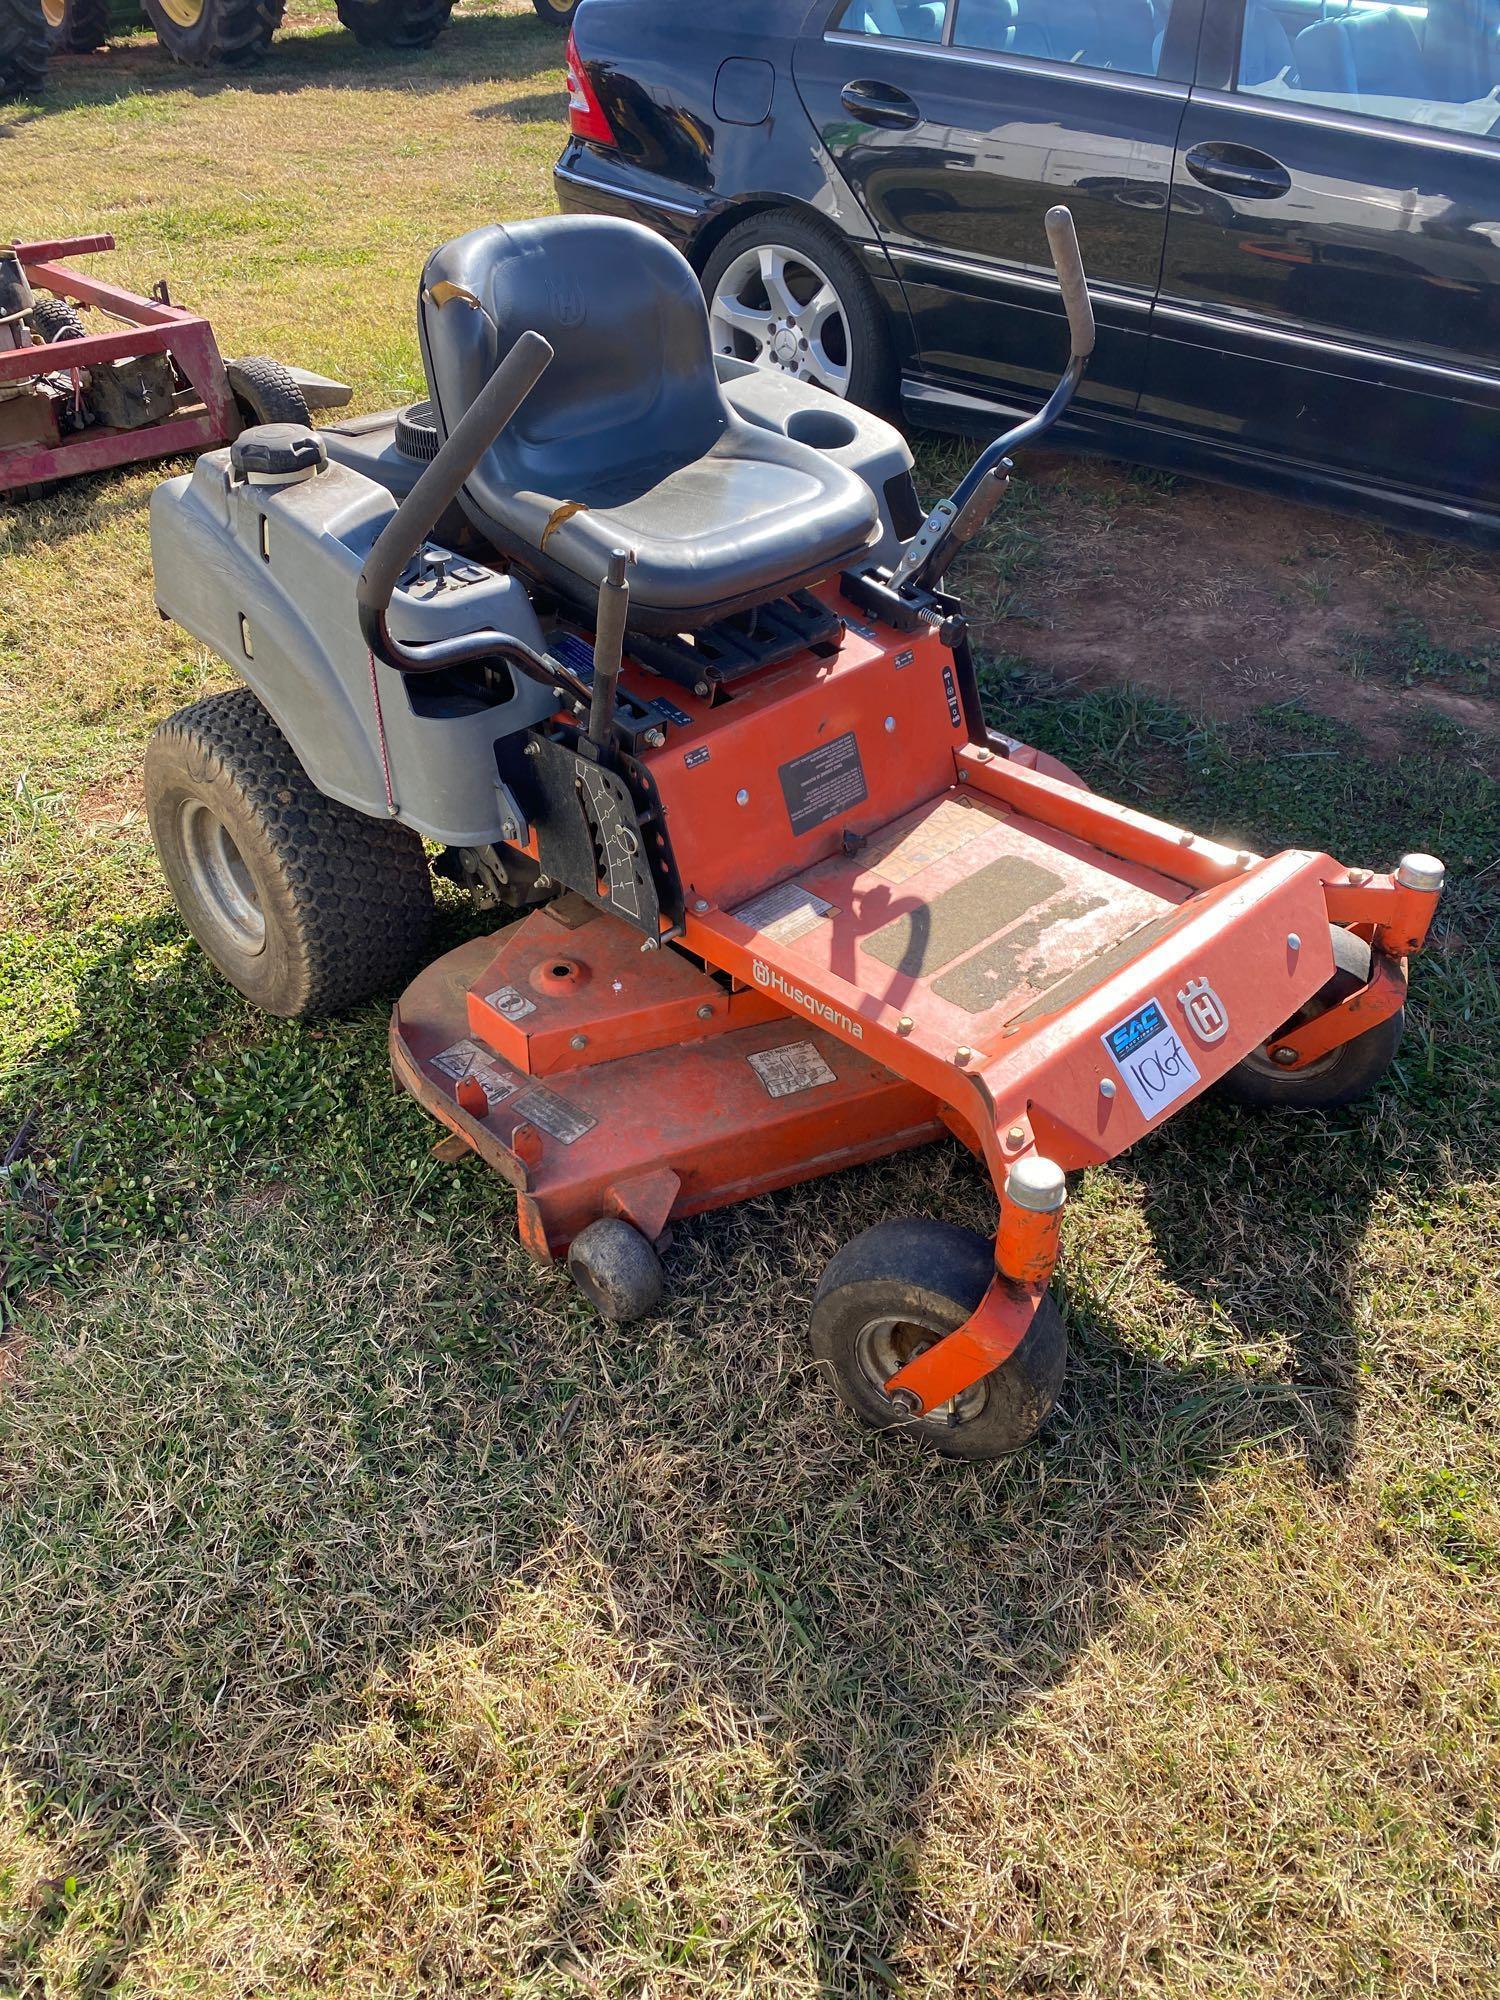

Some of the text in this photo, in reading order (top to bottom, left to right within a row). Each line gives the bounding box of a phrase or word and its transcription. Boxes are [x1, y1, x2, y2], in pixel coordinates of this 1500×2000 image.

[771, 972, 863, 1040] Husqvarna
[1113, 1006, 1158, 1052] SAC
[1130, 1036, 1191, 1100] 1067
